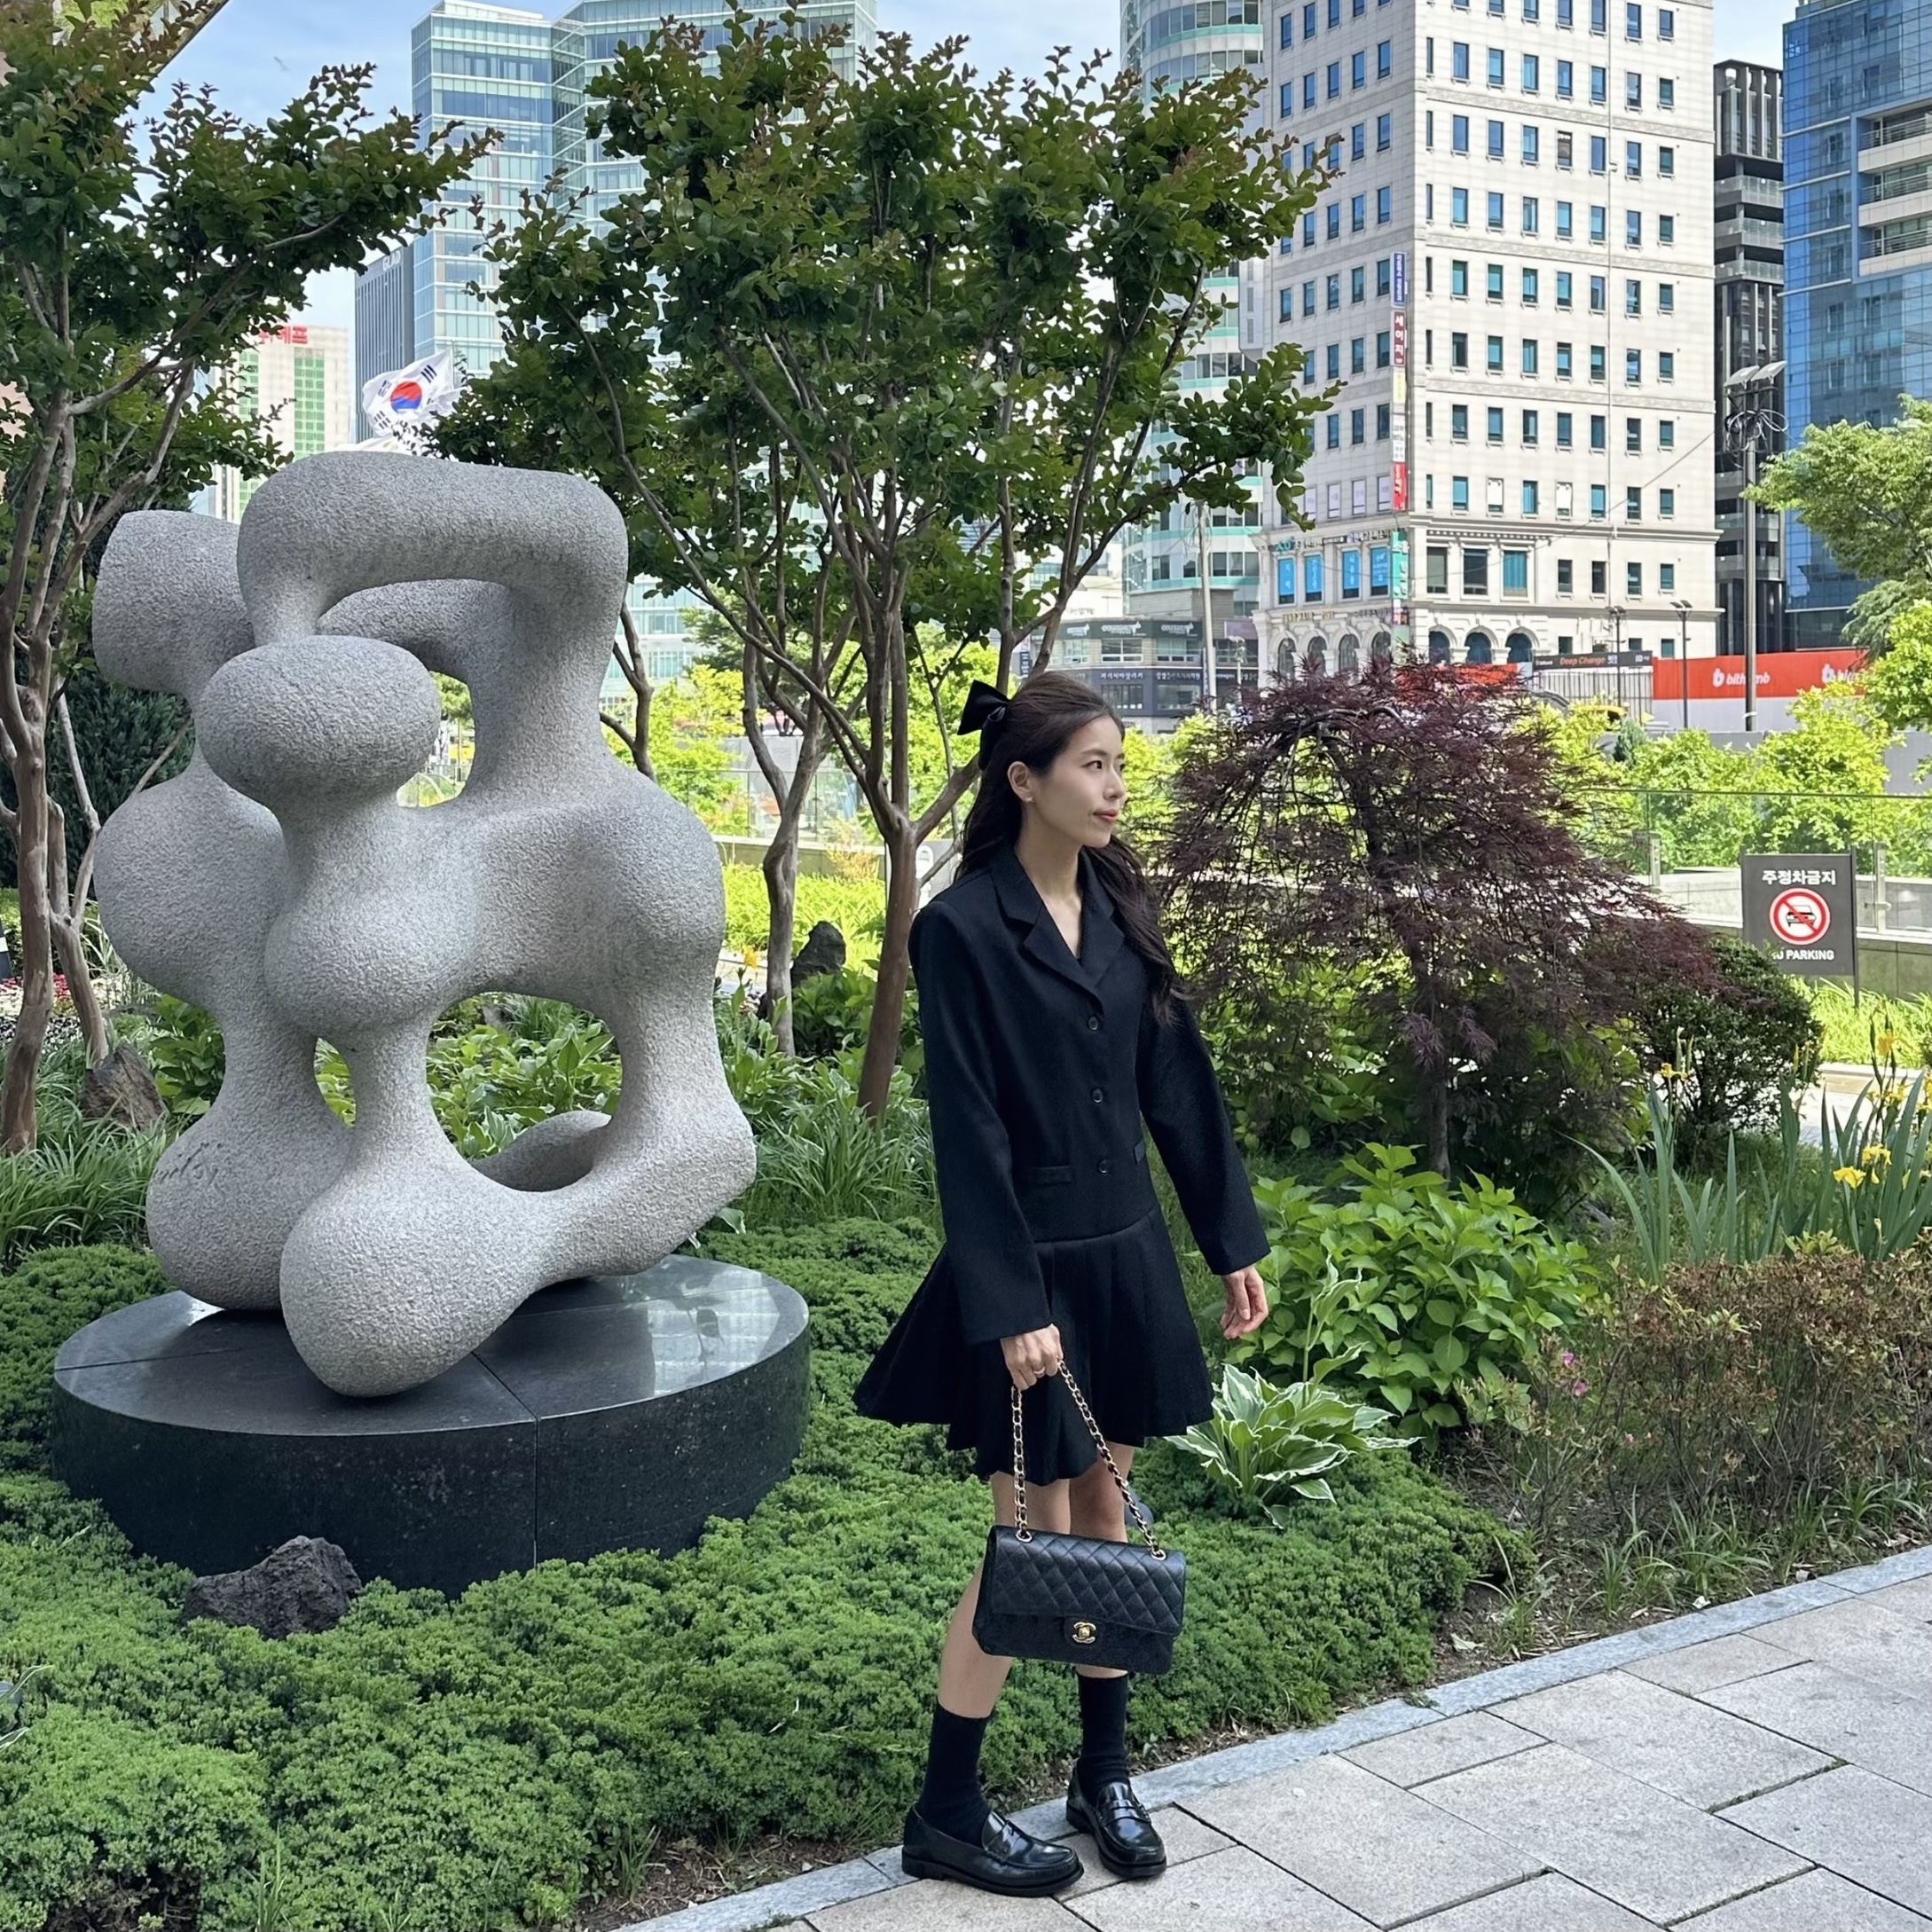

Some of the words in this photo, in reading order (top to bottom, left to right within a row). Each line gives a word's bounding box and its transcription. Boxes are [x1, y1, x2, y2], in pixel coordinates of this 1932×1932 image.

[1394, 315, 1404, 356] 세이지
[1559, 657, 1578, 666] Deep
[1726, 671, 1771, 686] bithmb
[1762, 869, 1836, 885] 주정차금지
[1787, 949, 1834, 961] PARKING
